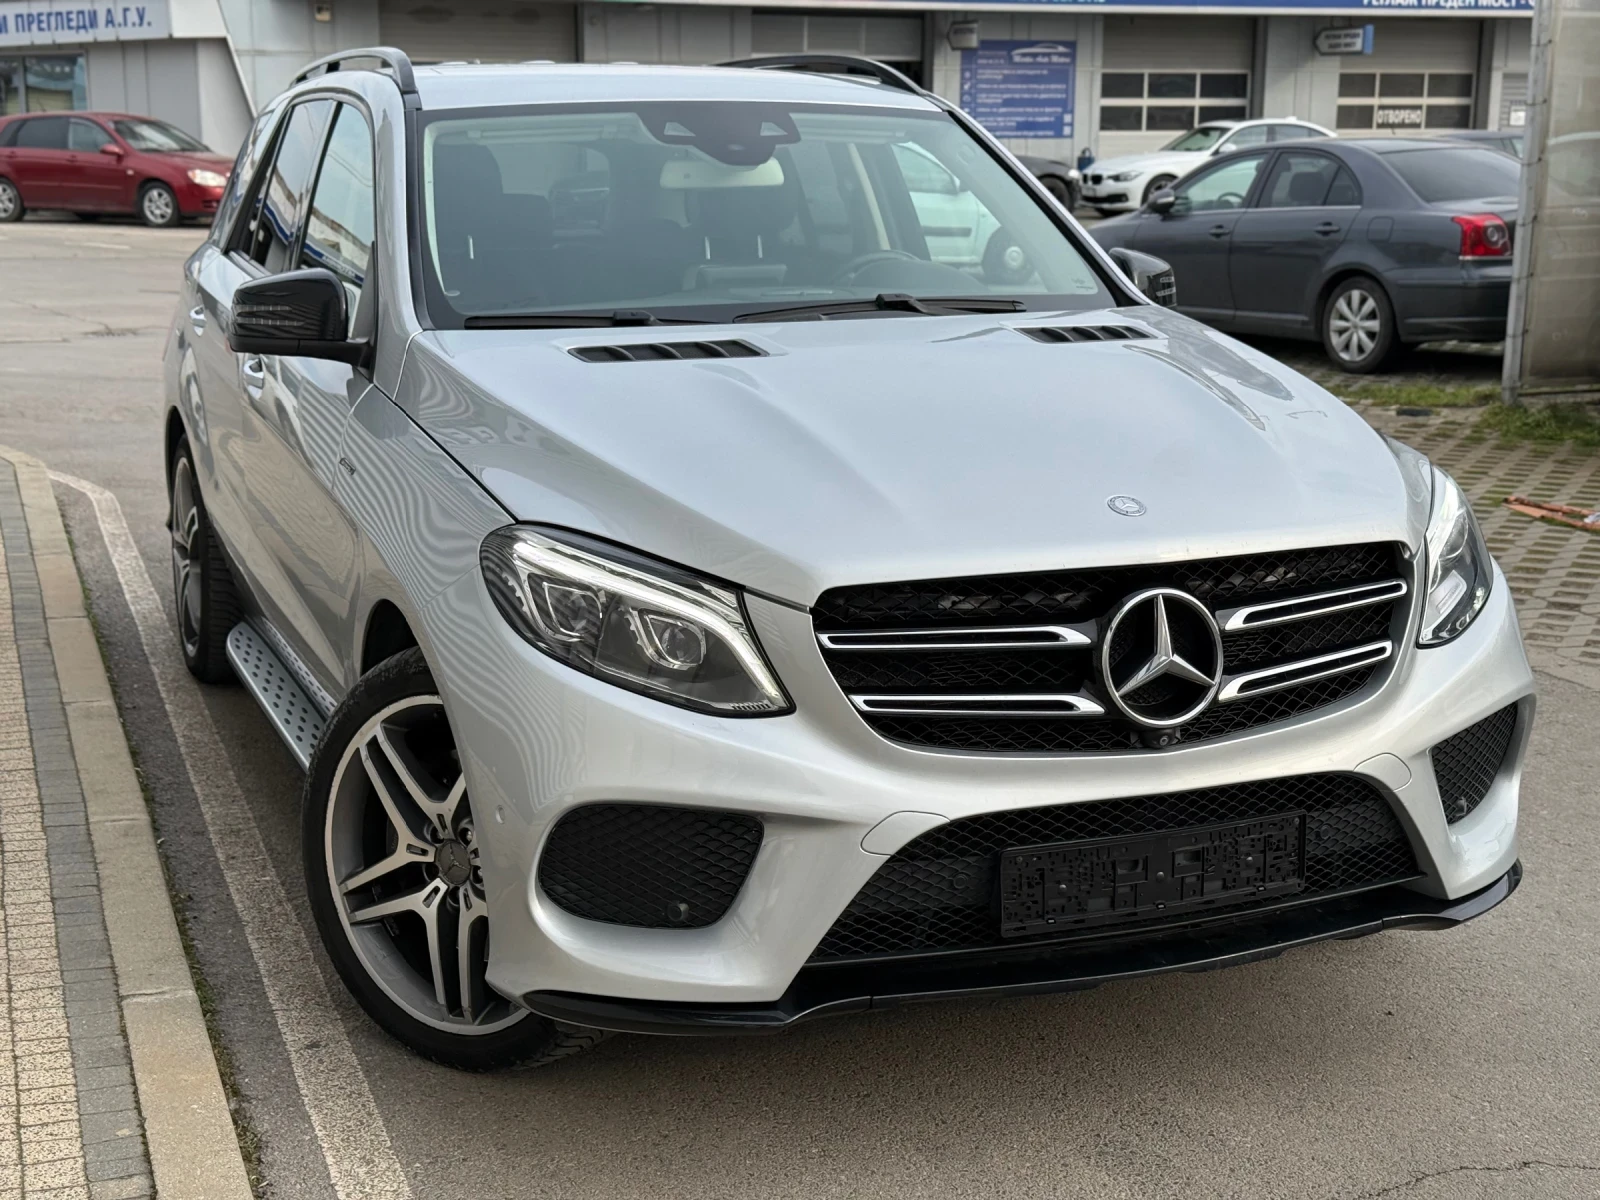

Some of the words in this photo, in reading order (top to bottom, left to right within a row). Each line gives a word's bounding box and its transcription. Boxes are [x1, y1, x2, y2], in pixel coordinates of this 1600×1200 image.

[14, 9, 99, 34] ПРЕГЛЕДИ
[104, 6, 152, 29] А.Г.У.
[1376, 109, 1422, 124] ОТВОРЕНО
